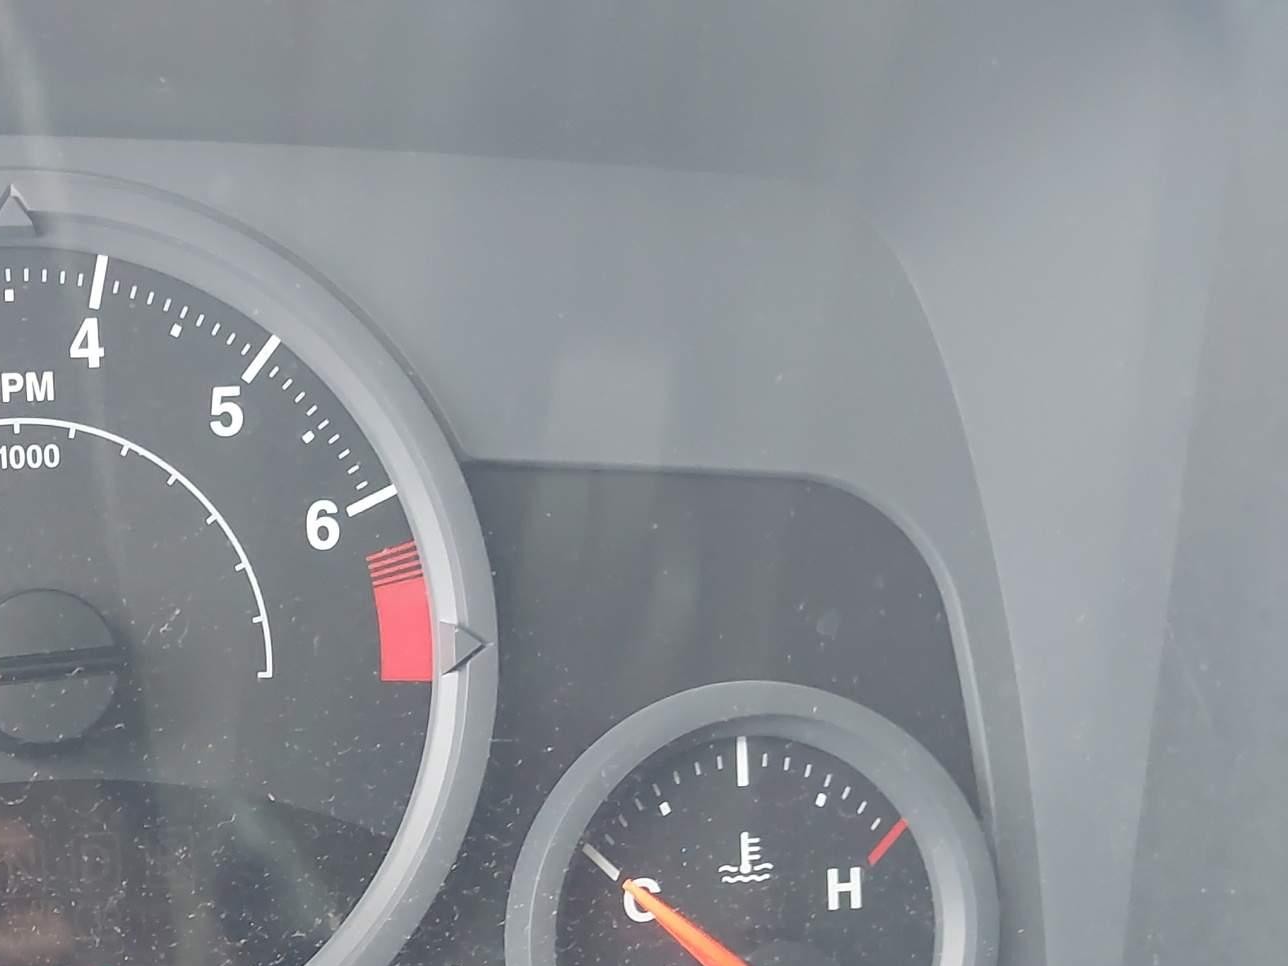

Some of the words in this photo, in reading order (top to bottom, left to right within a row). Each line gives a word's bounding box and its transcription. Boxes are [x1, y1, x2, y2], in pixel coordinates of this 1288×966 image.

[70, 318, 105, 368] 4
[210, 386, 244, 437] 5
[306, 500, 341, 550] 6
[623, 877, 661, 922] C
[827, 867, 862, 910] H
